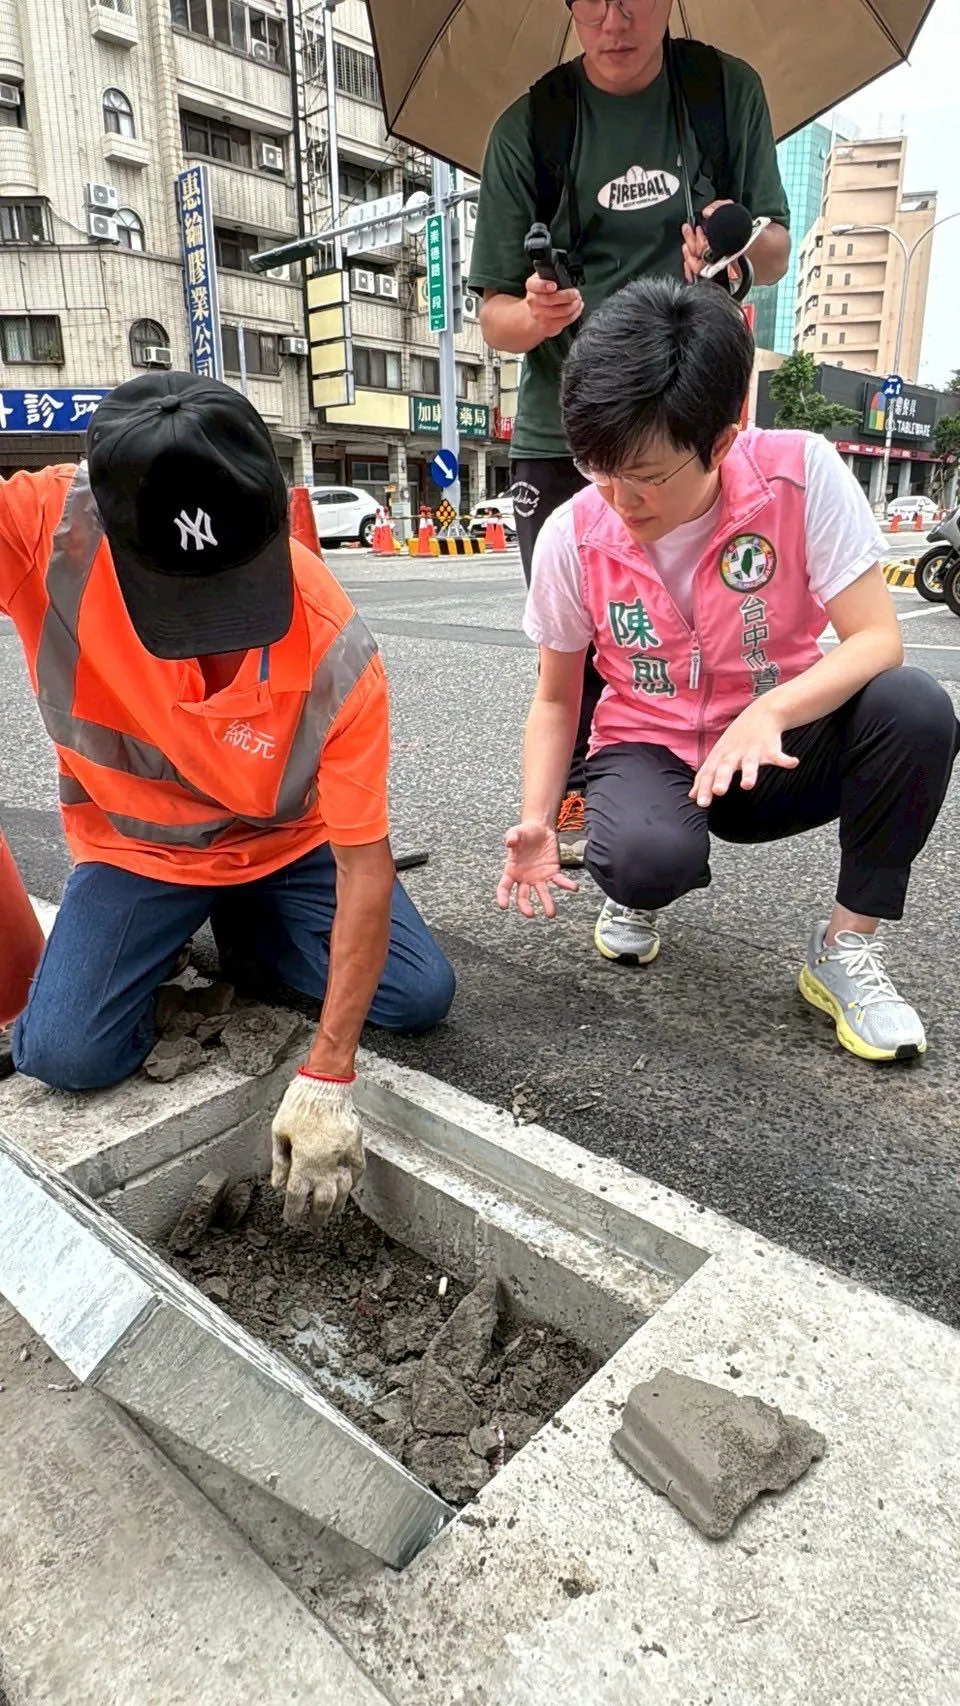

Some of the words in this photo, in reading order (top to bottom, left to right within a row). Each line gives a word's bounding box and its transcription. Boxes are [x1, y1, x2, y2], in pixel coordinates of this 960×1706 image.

[608, 173, 671, 209] FIREBALL
[430, 229, 442, 309] 崇德路一段
[417, 402, 487, 427] 加康藥局
[173, 508, 218, 550] NY
[223, 719, 276, 761] 統元
